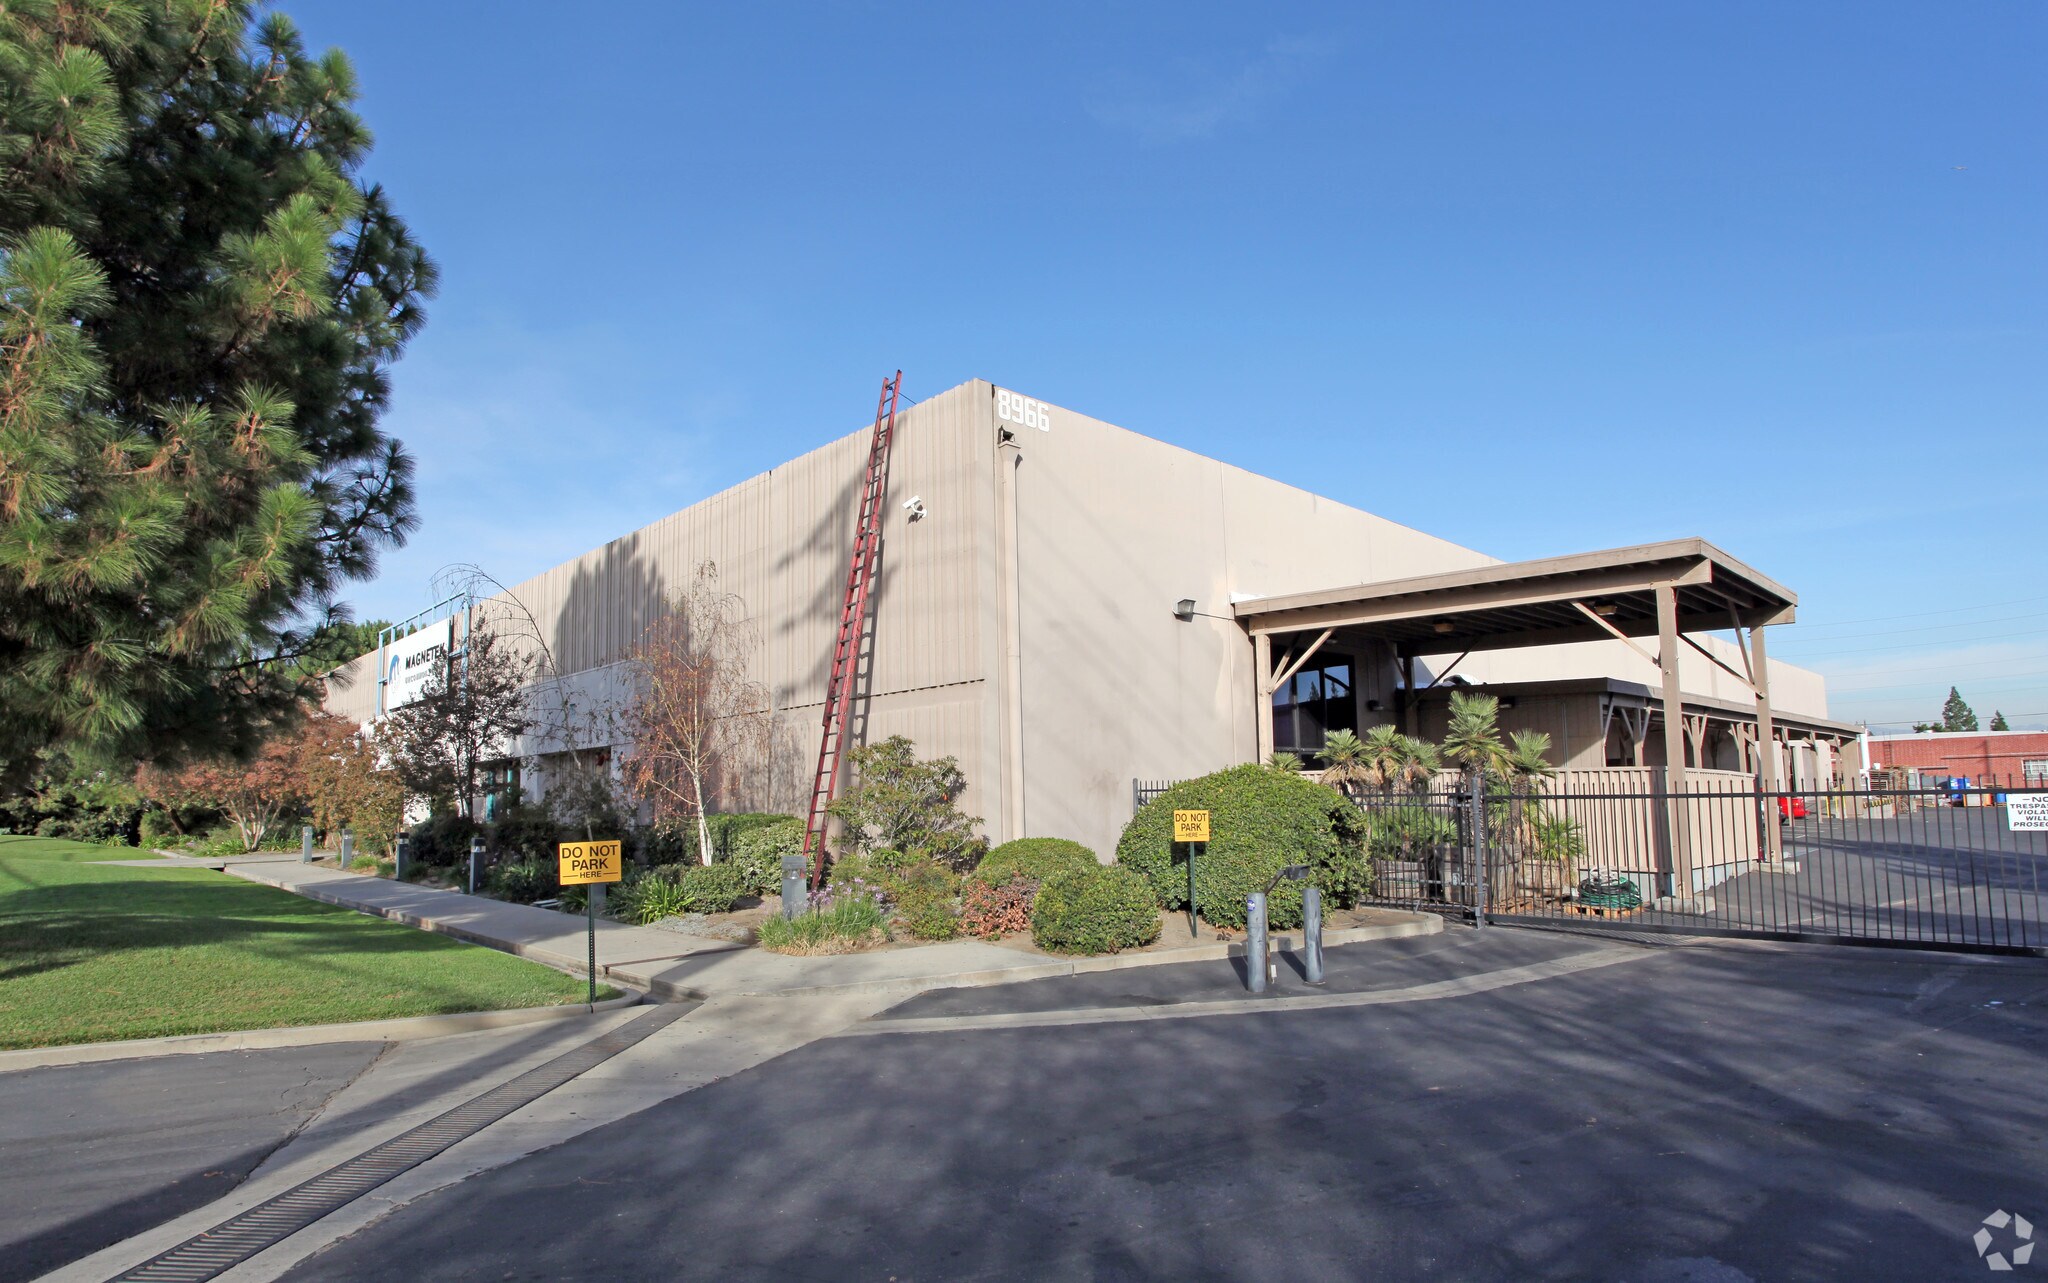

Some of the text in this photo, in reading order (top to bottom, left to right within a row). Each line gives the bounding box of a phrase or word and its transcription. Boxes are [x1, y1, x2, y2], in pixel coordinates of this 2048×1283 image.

[998, 389, 1050, 433] 8966
[405, 642, 447, 670] MAGNETEK
[1175, 813, 1207, 822] DO NOT
[1181, 823, 1202, 832] PARK
[562, 844, 618, 859] DO NOT
[572, 857, 608, 871] PARK
[580, 870, 602, 879] HERE
